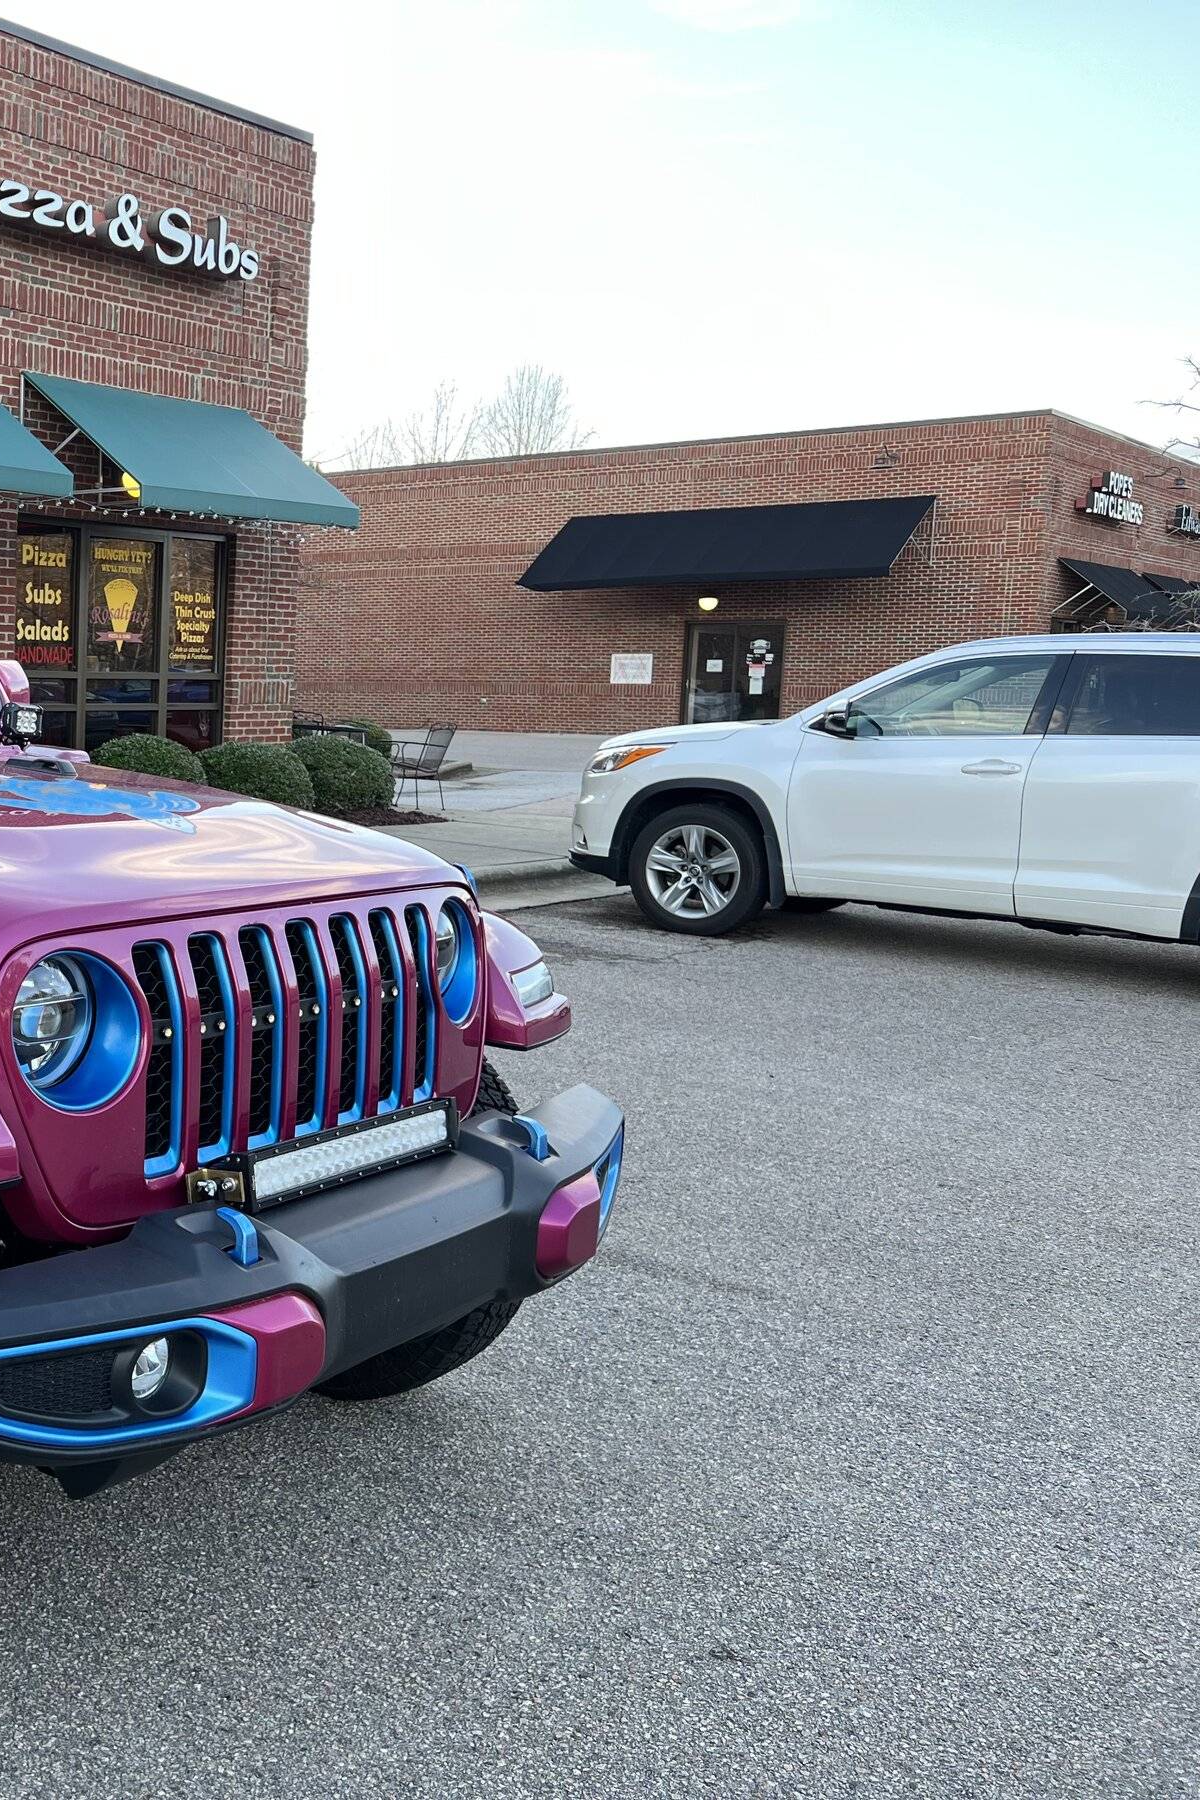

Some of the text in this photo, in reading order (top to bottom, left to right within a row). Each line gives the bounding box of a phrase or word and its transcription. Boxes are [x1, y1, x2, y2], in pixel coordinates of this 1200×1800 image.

[107, 193, 145, 251] &
[154, 205, 260, 281] Subs
[1093, 491, 1144, 525] DRY CLEANERS
[21, 543, 67, 568] Pizza
[94, 547, 129, 561] HUNGRY
[25, 581, 62, 605] Subs
[174, 591, 211, 604] Deep Dish
[175, 606, 215, 619] Thin Crust
[16, 618, 70, 642] Salads
[176, 620, 210, 633] Specialty
[181, 632, 205, 643] Pizzas
